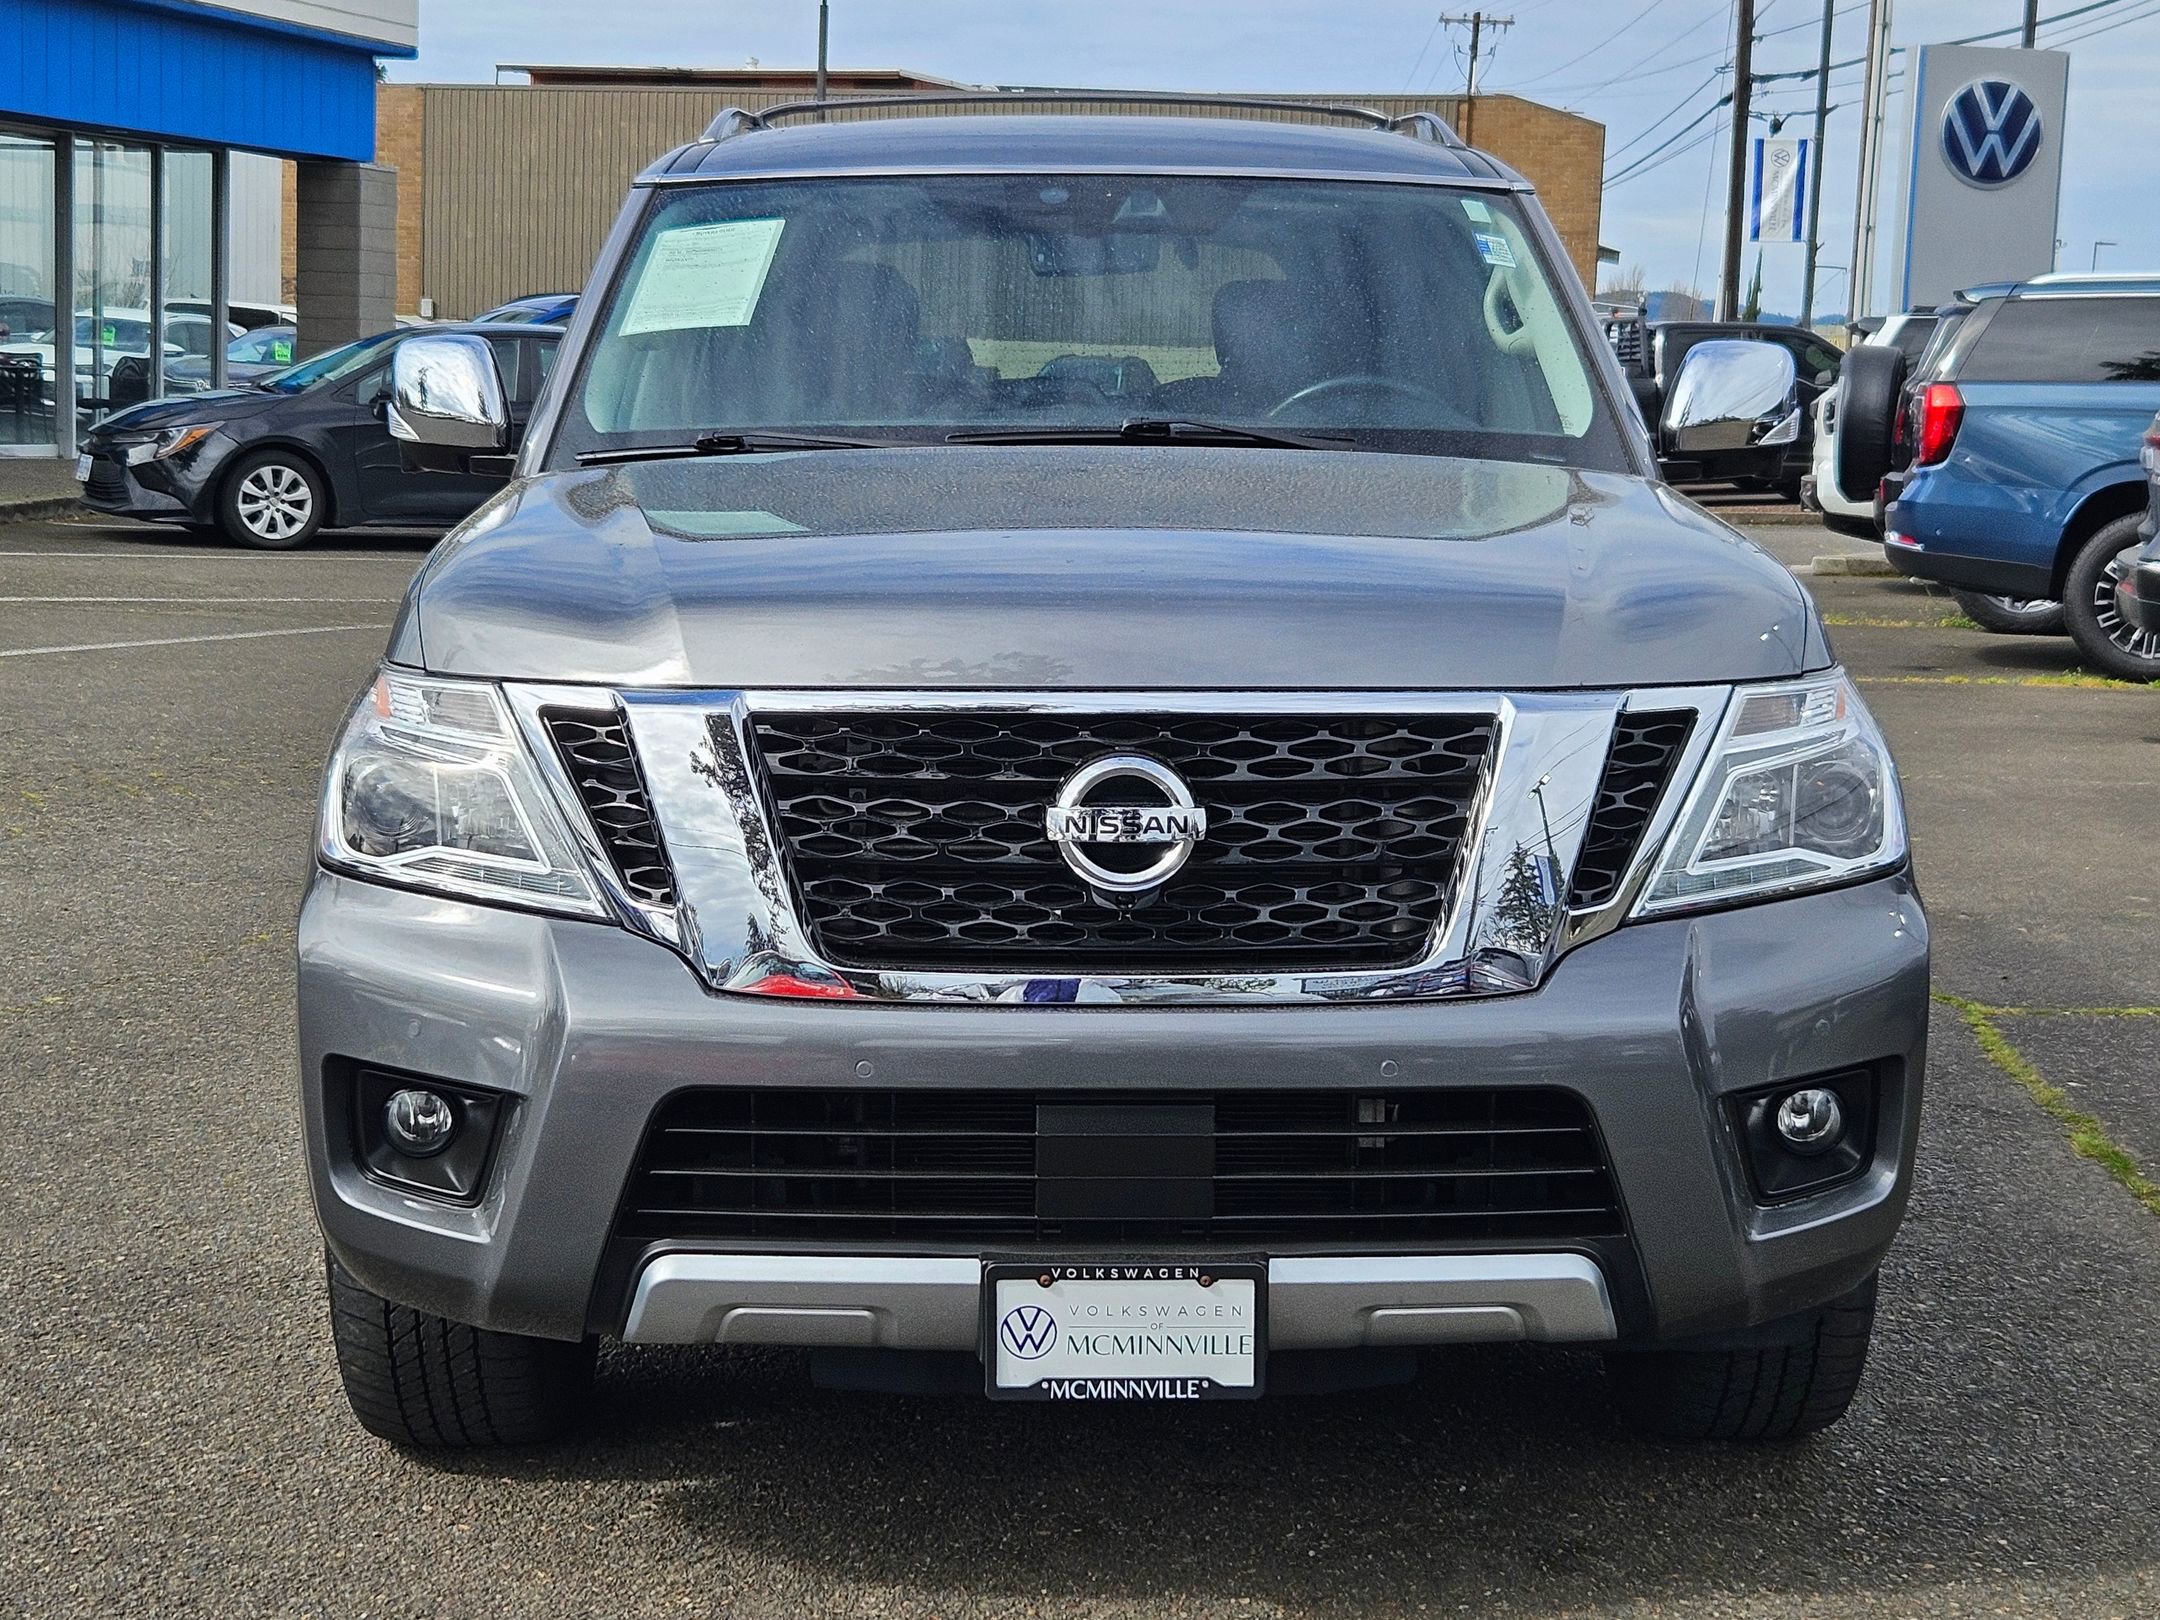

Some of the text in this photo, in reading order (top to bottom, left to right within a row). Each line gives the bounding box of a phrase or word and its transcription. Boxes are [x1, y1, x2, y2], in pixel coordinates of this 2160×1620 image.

[1065, 815, 1189, 834] NISSAN
[1051, 1267, 1201, 1279] VOLKSWAGEN
[1069, 1304, 1243, 1317] VOLKSWAGEN
[1150, 1322, 1165, 1331] OF
[1067, 1334, 1253, 1356] MCMINNVILLE
[1050, 1380, 1200, 1400] MCMINNVILLE
